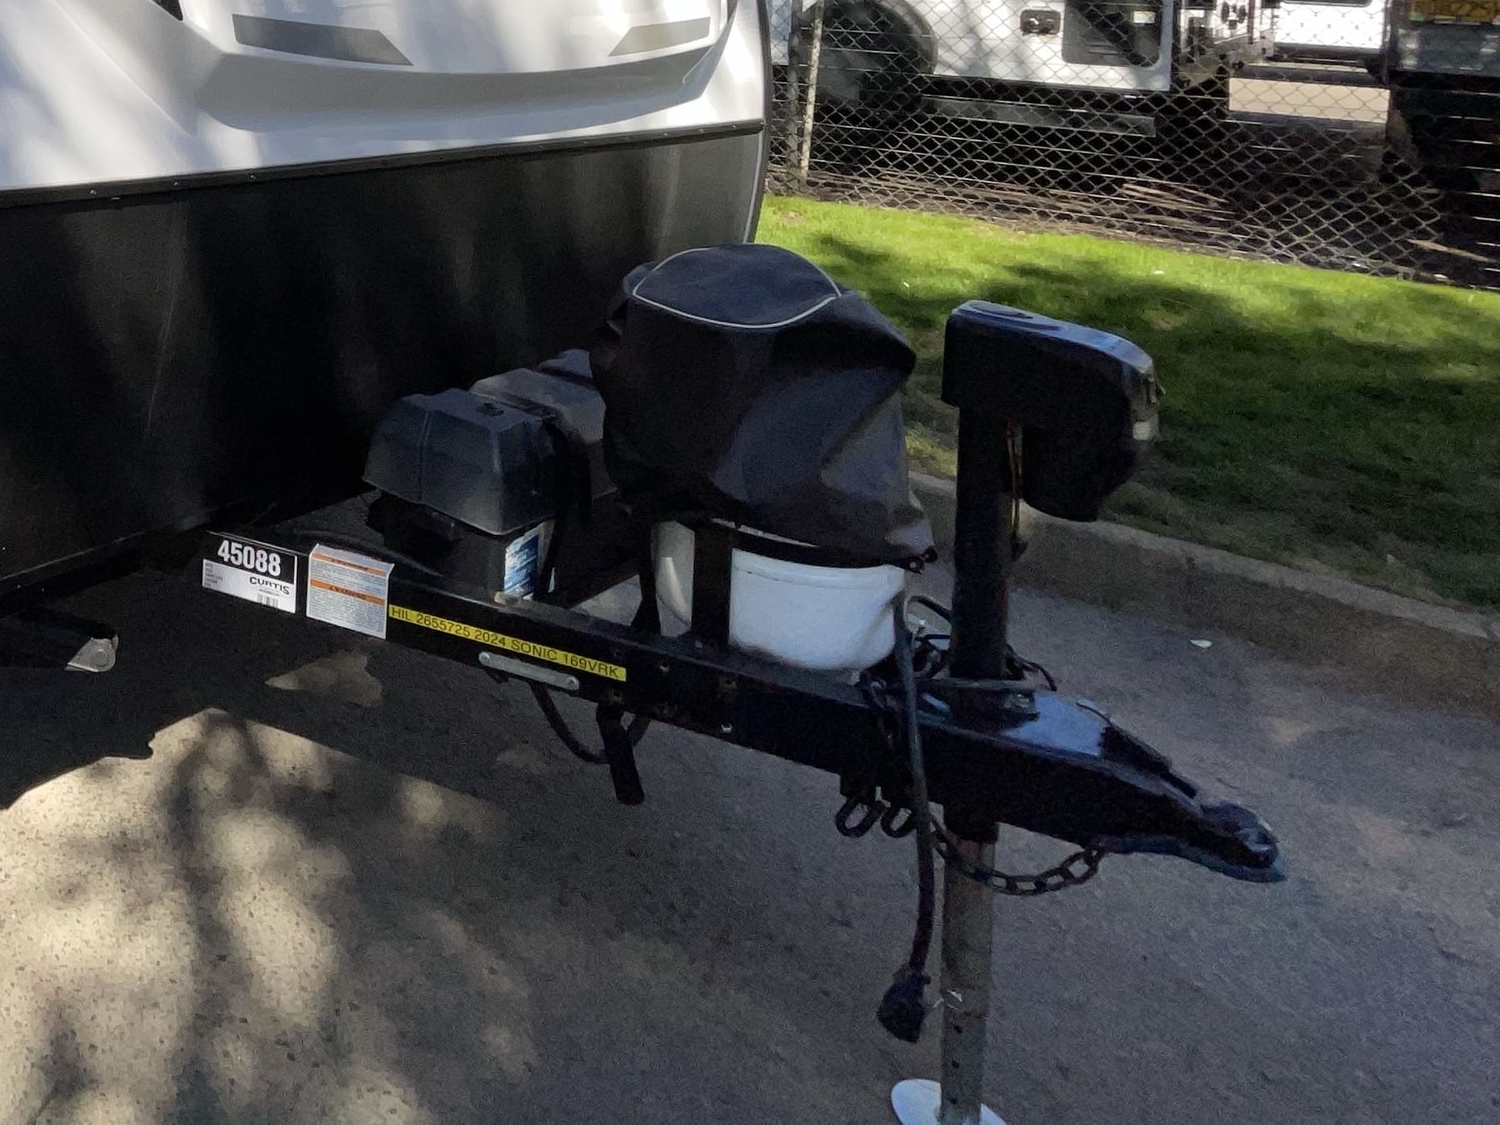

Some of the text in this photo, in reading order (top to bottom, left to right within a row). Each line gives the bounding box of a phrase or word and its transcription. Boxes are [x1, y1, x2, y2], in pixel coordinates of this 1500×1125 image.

[217, 539, 281, 577] 45088
[249, 576, 290, 595] CURTIS
[391, 606, 411, 622] HIL
[416, 613, 471, 637] 2655725
[474, 628, 506, 648] 2024
[510, 638, 557, 661] SONIC
[563, 654, 620, 679] 169VRK
